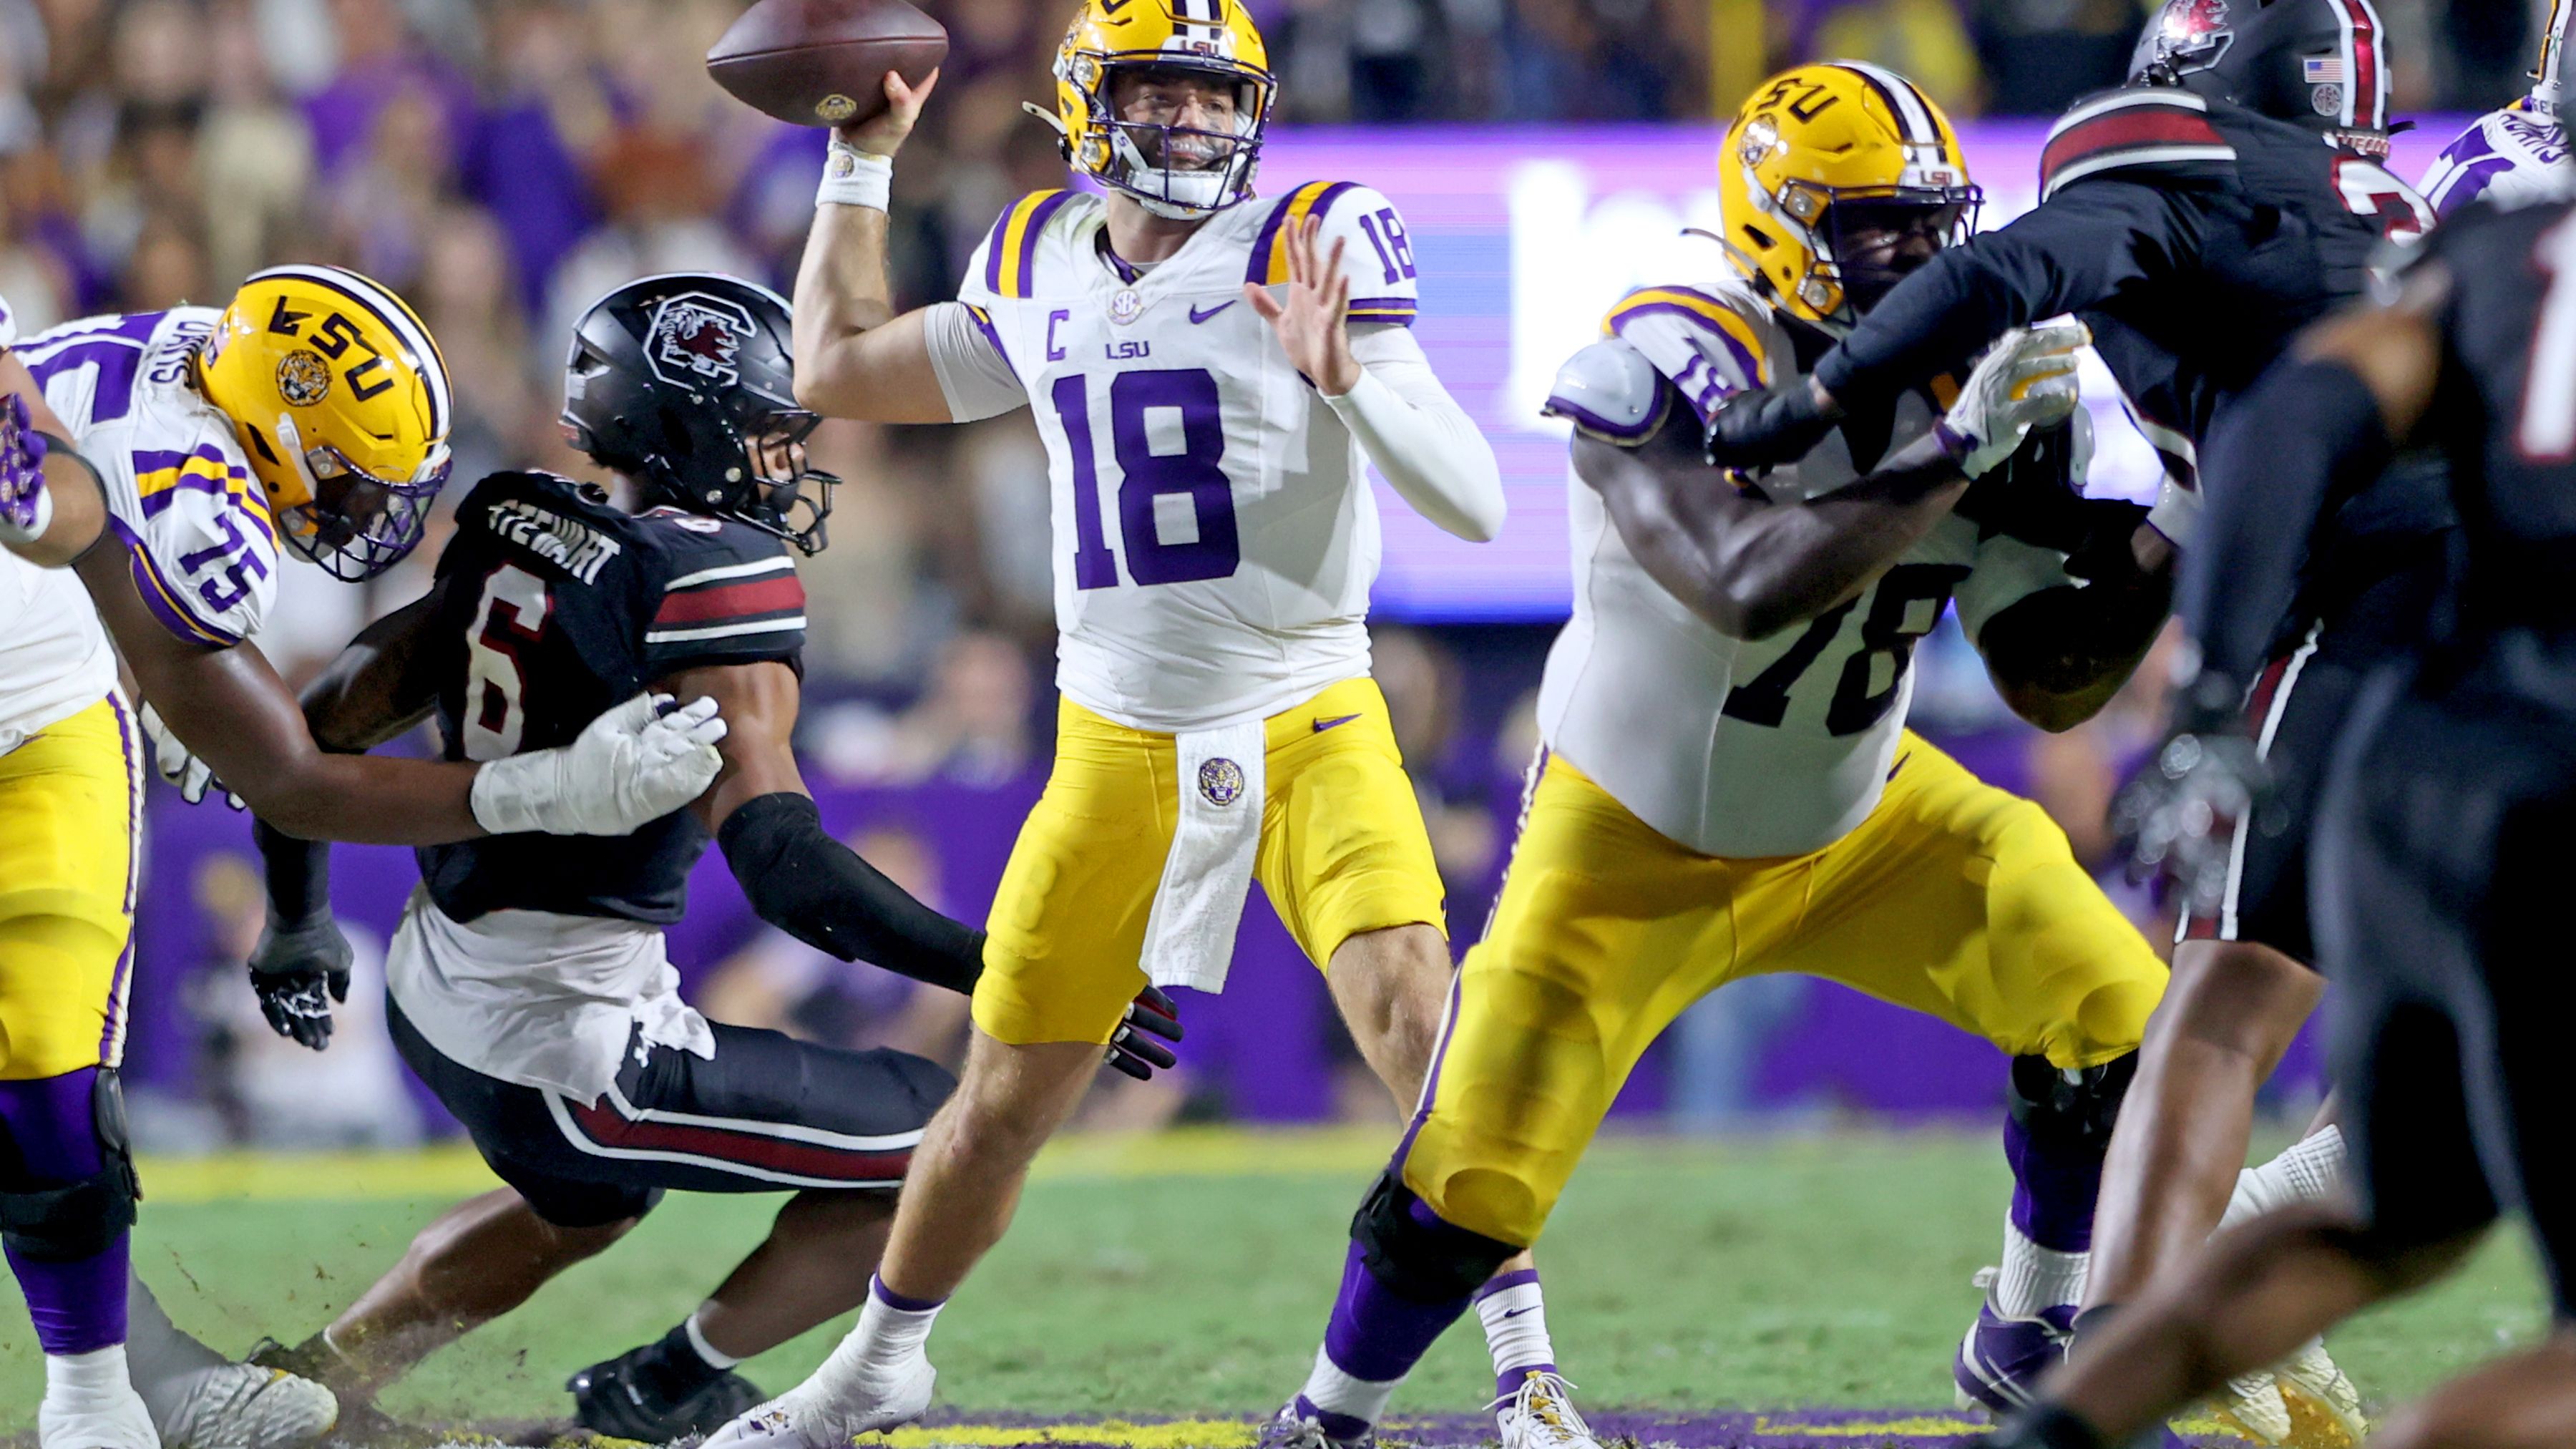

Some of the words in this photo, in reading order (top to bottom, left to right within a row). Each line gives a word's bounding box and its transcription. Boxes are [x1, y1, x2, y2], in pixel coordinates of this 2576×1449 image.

[1359, 208, 1416, 286] 18
[268, 296, 394, 402] LSU
[1046, 309, 1070, 361] C
[1105, 341, 1150, 359] LSU
[1052, 369, 1239, 590] 18
[177, 512, 268, 614] 75
[464, 560, 554, 762] 6
[1721, 563, 1973, 737] 78
